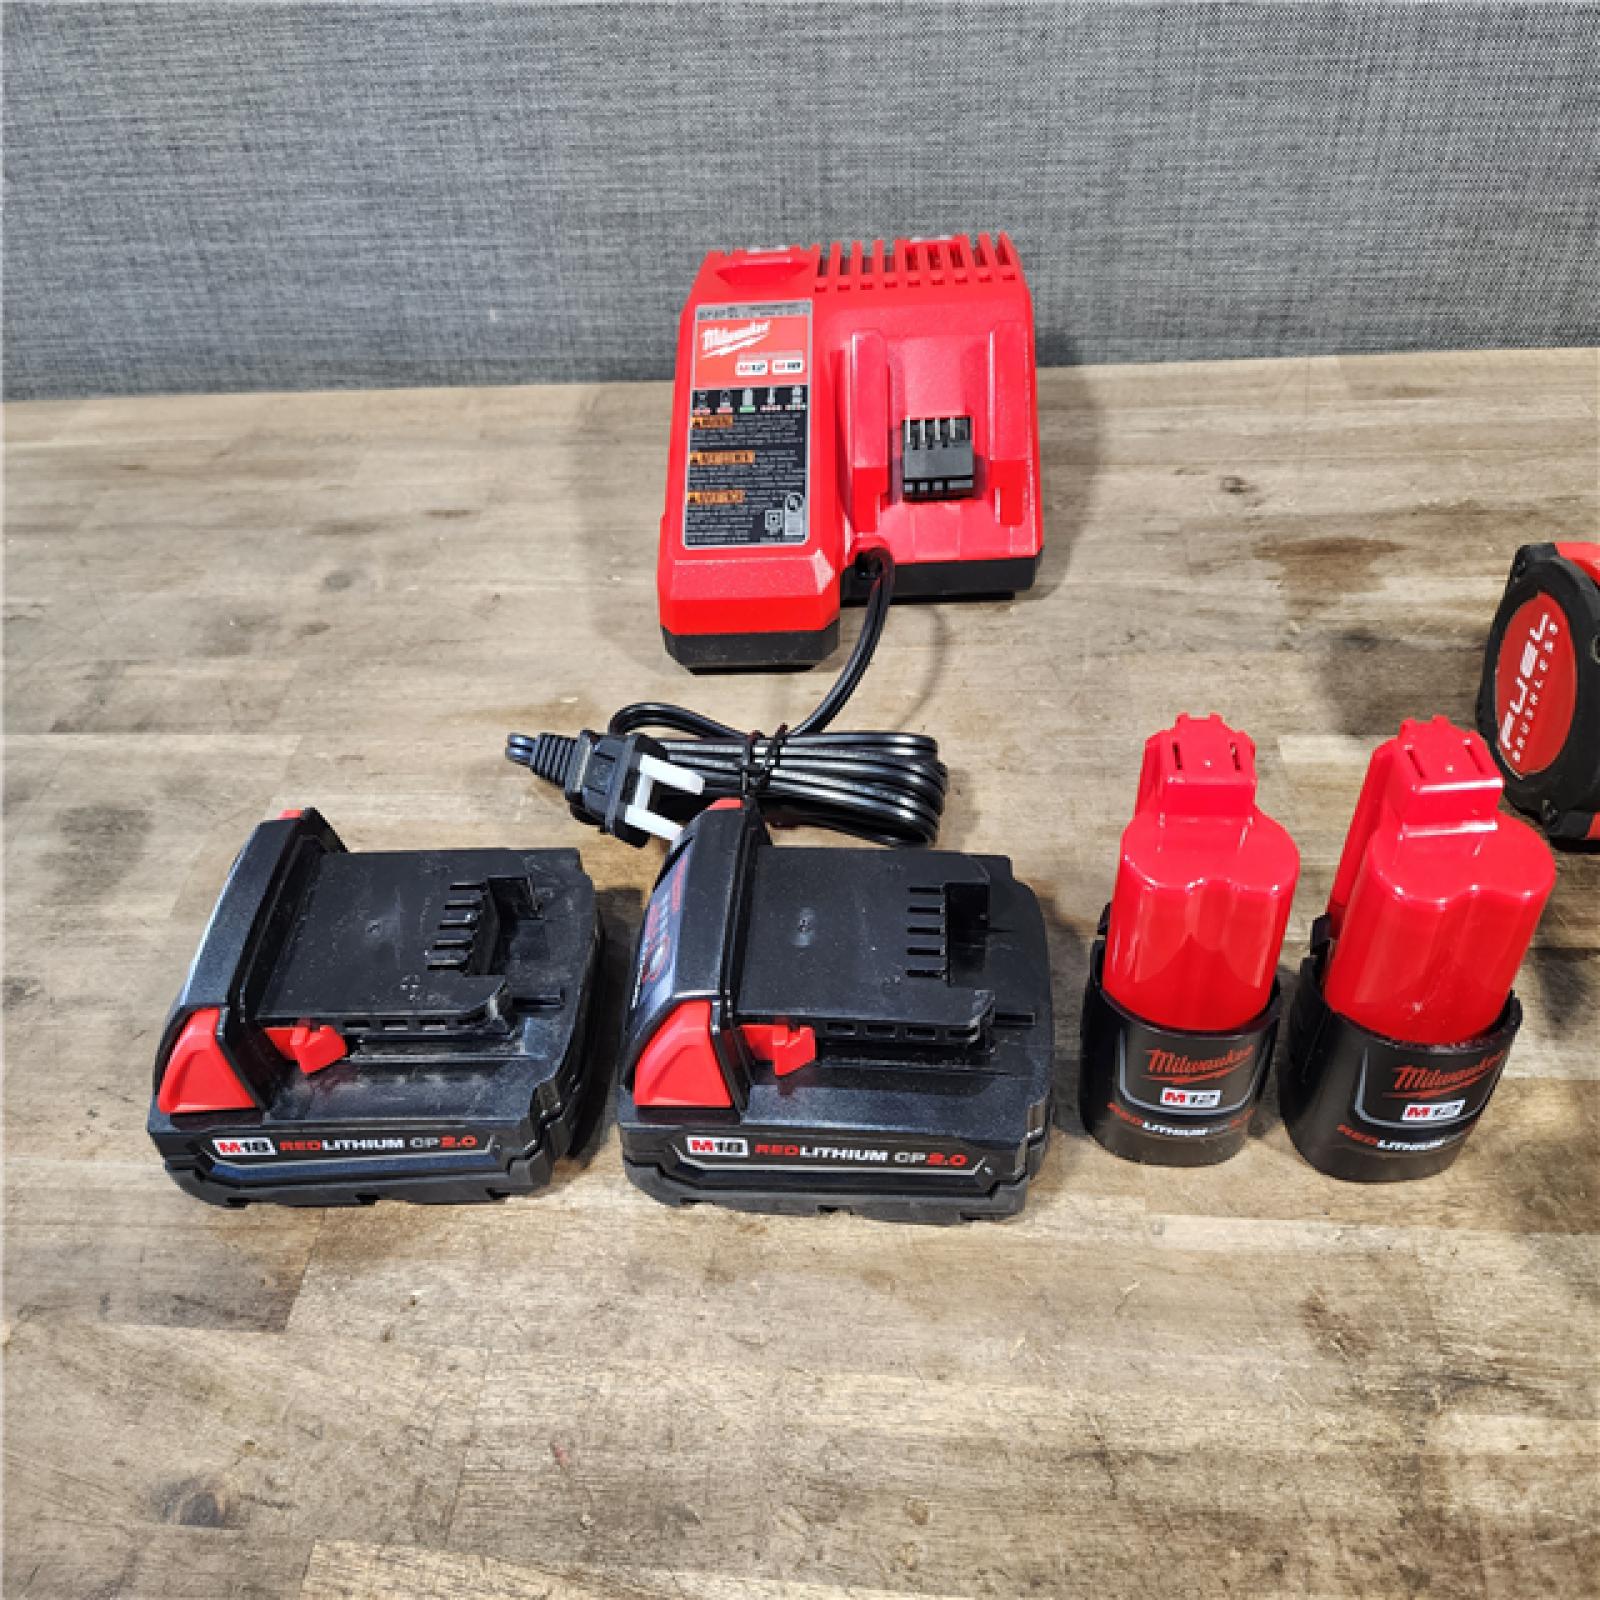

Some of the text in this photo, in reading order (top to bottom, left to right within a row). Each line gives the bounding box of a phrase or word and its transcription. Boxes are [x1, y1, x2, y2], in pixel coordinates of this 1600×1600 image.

[1502, 613, 1549, 750] FUEL
[1144, 1044, 1254, 1076] Milwaukee
[1163, 1090, 1217, 1105] M12
[1406, 1102, 1461, 1118] M12
[216, 1139, 272, 1154] M18
[279, 1137, 405, 1152] REDLITHIUM
[690, 1138, 745, 1154] M18
[754, 1143, 888, 1163] REDLITHIUM
